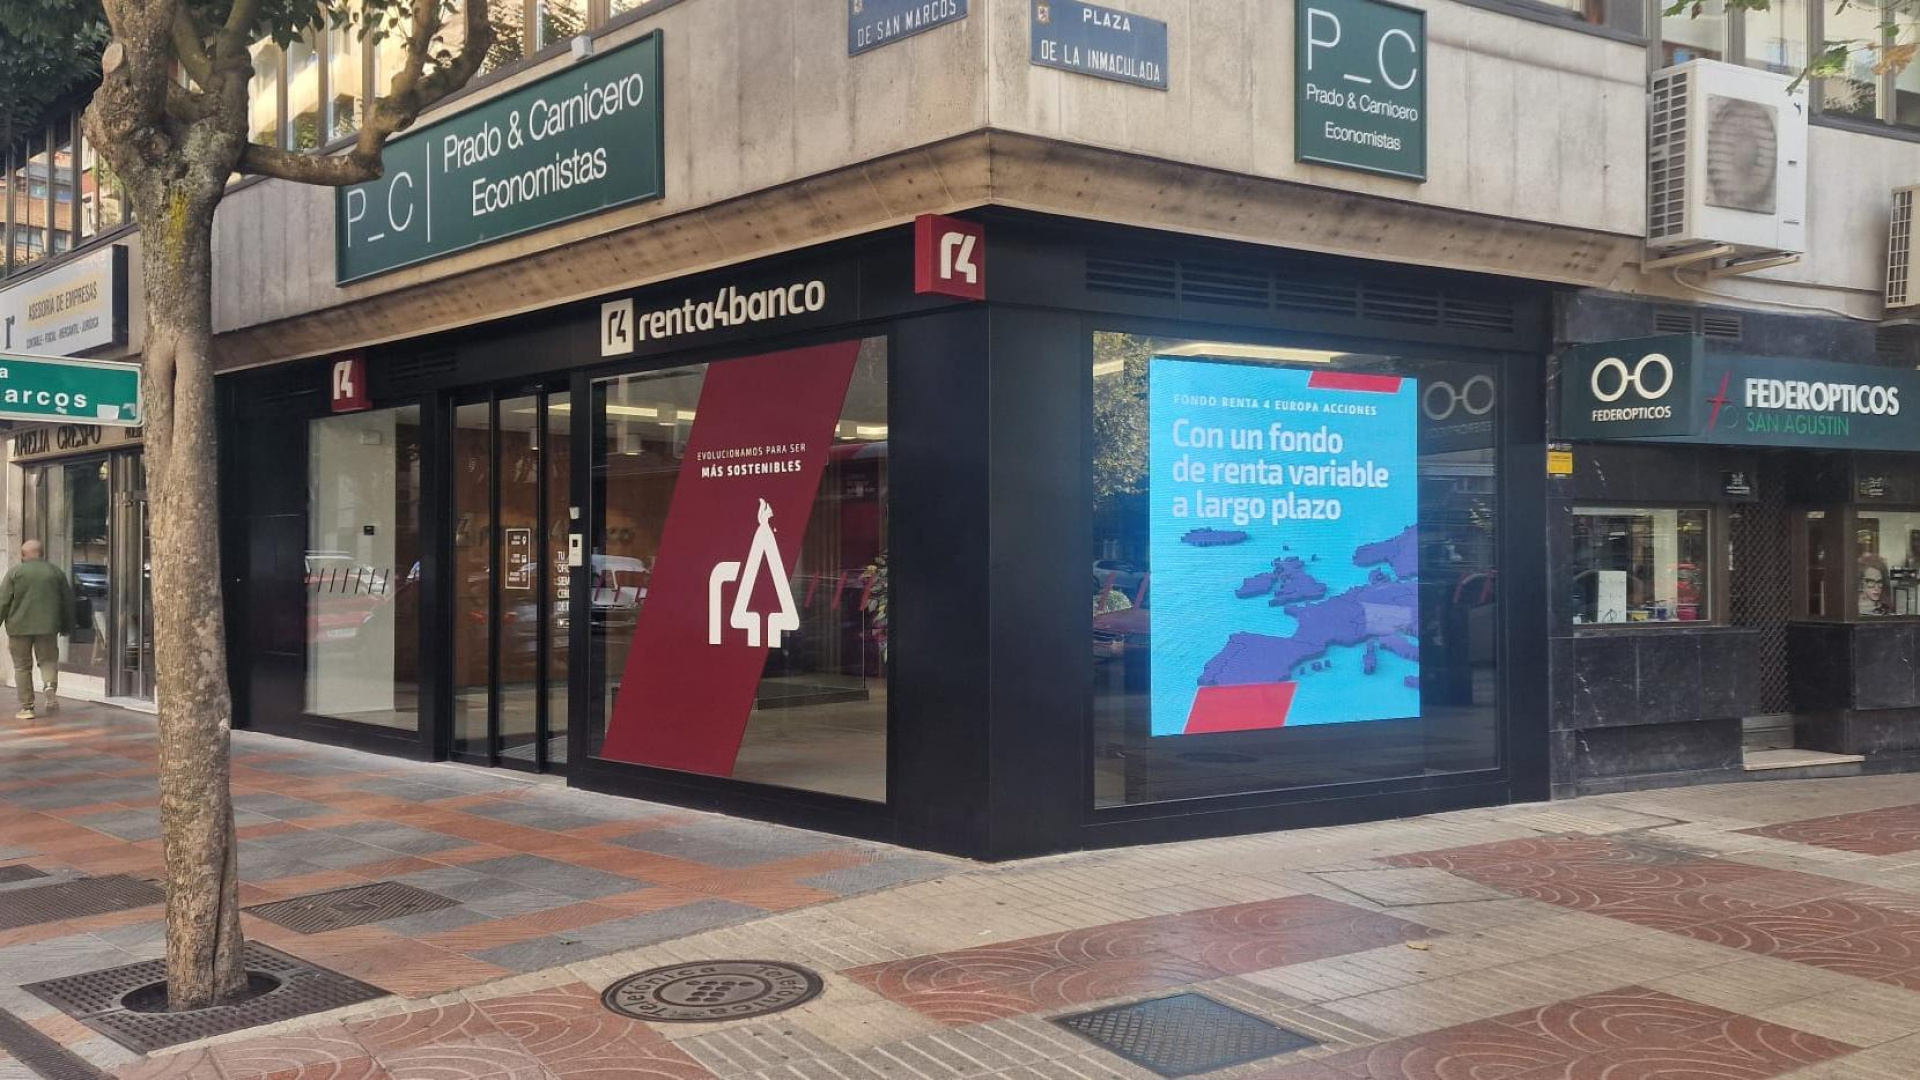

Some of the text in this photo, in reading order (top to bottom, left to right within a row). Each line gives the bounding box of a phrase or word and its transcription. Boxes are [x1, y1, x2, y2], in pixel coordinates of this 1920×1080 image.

[857, 0, 957, 47] DE SAN MARCOS
[1083, 8, 1131, 32] PLAZA
[1041, 40, 1160, 83] DE LA INMACULADA
[1306, 83, 1418, 121] Prado & Carnicero
[444, 73, 644, 173] Prado & Carnicero
[1325, 121, 1401, 150] Economistas
[472, 147, 607, 217] Economistas
[56, 294, 64, 313] DE
[65, 281, 97, 310] EMPRESAS
[638, 280, 826, 341] renta4banco
[1174, 394, 1377, 416] FONDO RENTA 4 EUROPA ACCIONES
[1592, 406, 1671, 422] FEDEROPTICOS
[1745, 377, 1900, 416] FEDEROPTICOS
[1172, 418, 1343, 454] Con un fondo
[1746, 413, 1779, 432] SAN
[14, 429, 51, 456] AMELIA
[57, 425, 101, 450] CRESPO
[697, 443, 806, 460] EVOLUCIONAMOS PARA SER
[702, 460, 802, 478] MÁS SOSTENIBLES
[1172, 454, 1389, 489] de renta variable
[1172, 490, 1342, 525] a largo plazo
